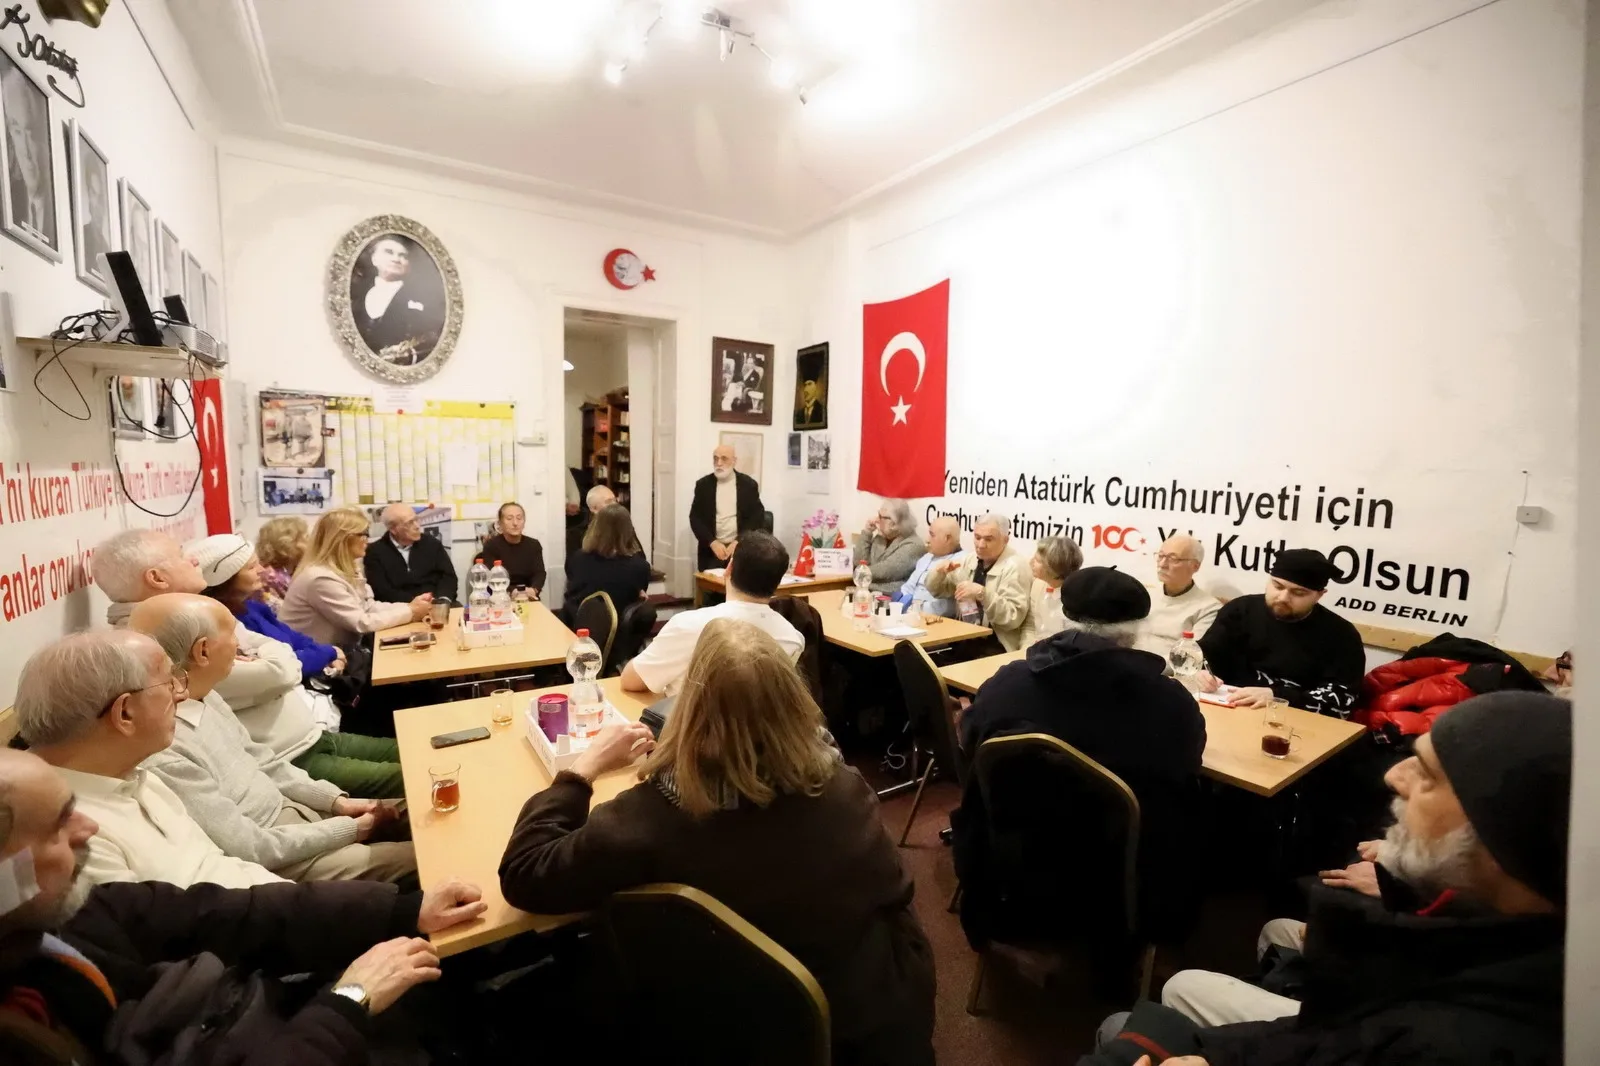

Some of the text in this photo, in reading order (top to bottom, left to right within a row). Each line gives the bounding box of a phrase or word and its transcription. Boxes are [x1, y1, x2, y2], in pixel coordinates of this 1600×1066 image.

[26, 462, 73, 519] kuran
[1014, 473, 1096, 505] Atatürk
[1105, 475, 1301, 527] Cumhuriyeti
[1315, 485, 1394, 531] için
[1214, 533, 1286, 573] Kut
[1327, 545, 1470, 601] Olsun
[1334, 596, 1469, 627] ADD BERLIN
